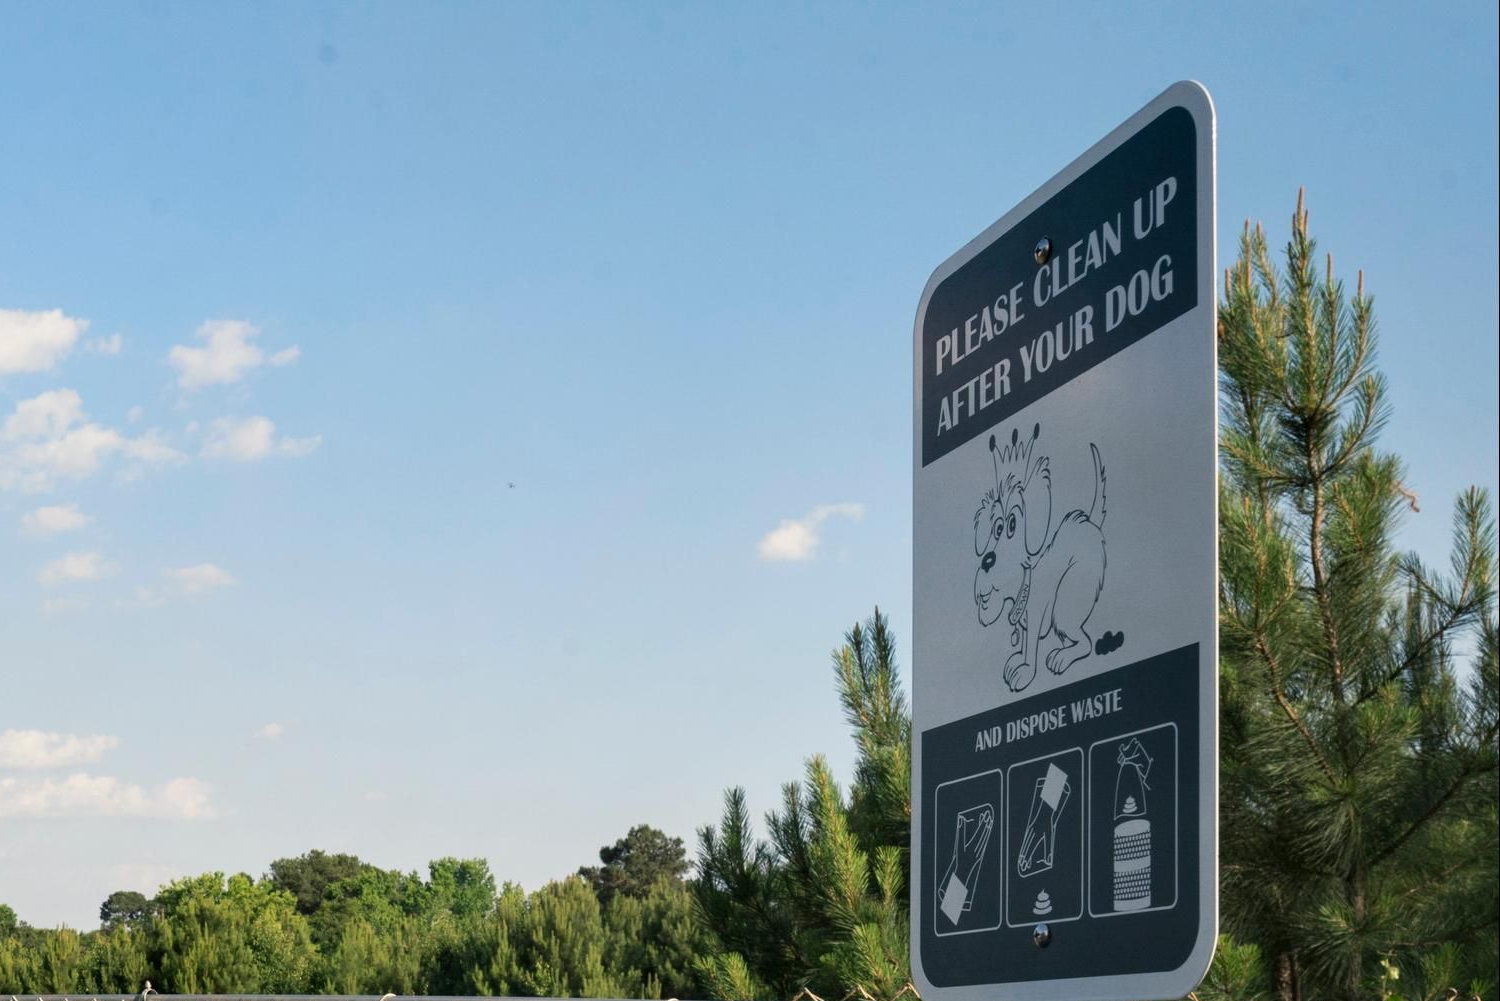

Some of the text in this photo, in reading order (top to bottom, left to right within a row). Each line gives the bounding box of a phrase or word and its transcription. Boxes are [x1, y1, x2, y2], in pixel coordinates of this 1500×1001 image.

[935, 176, 1178, 376] PLEASE CLEAN UP
[936, 254, 1174, 437] AFTER YOUR DOG
[975, 688, 1123, 752] AND DISPOSE WASTE
